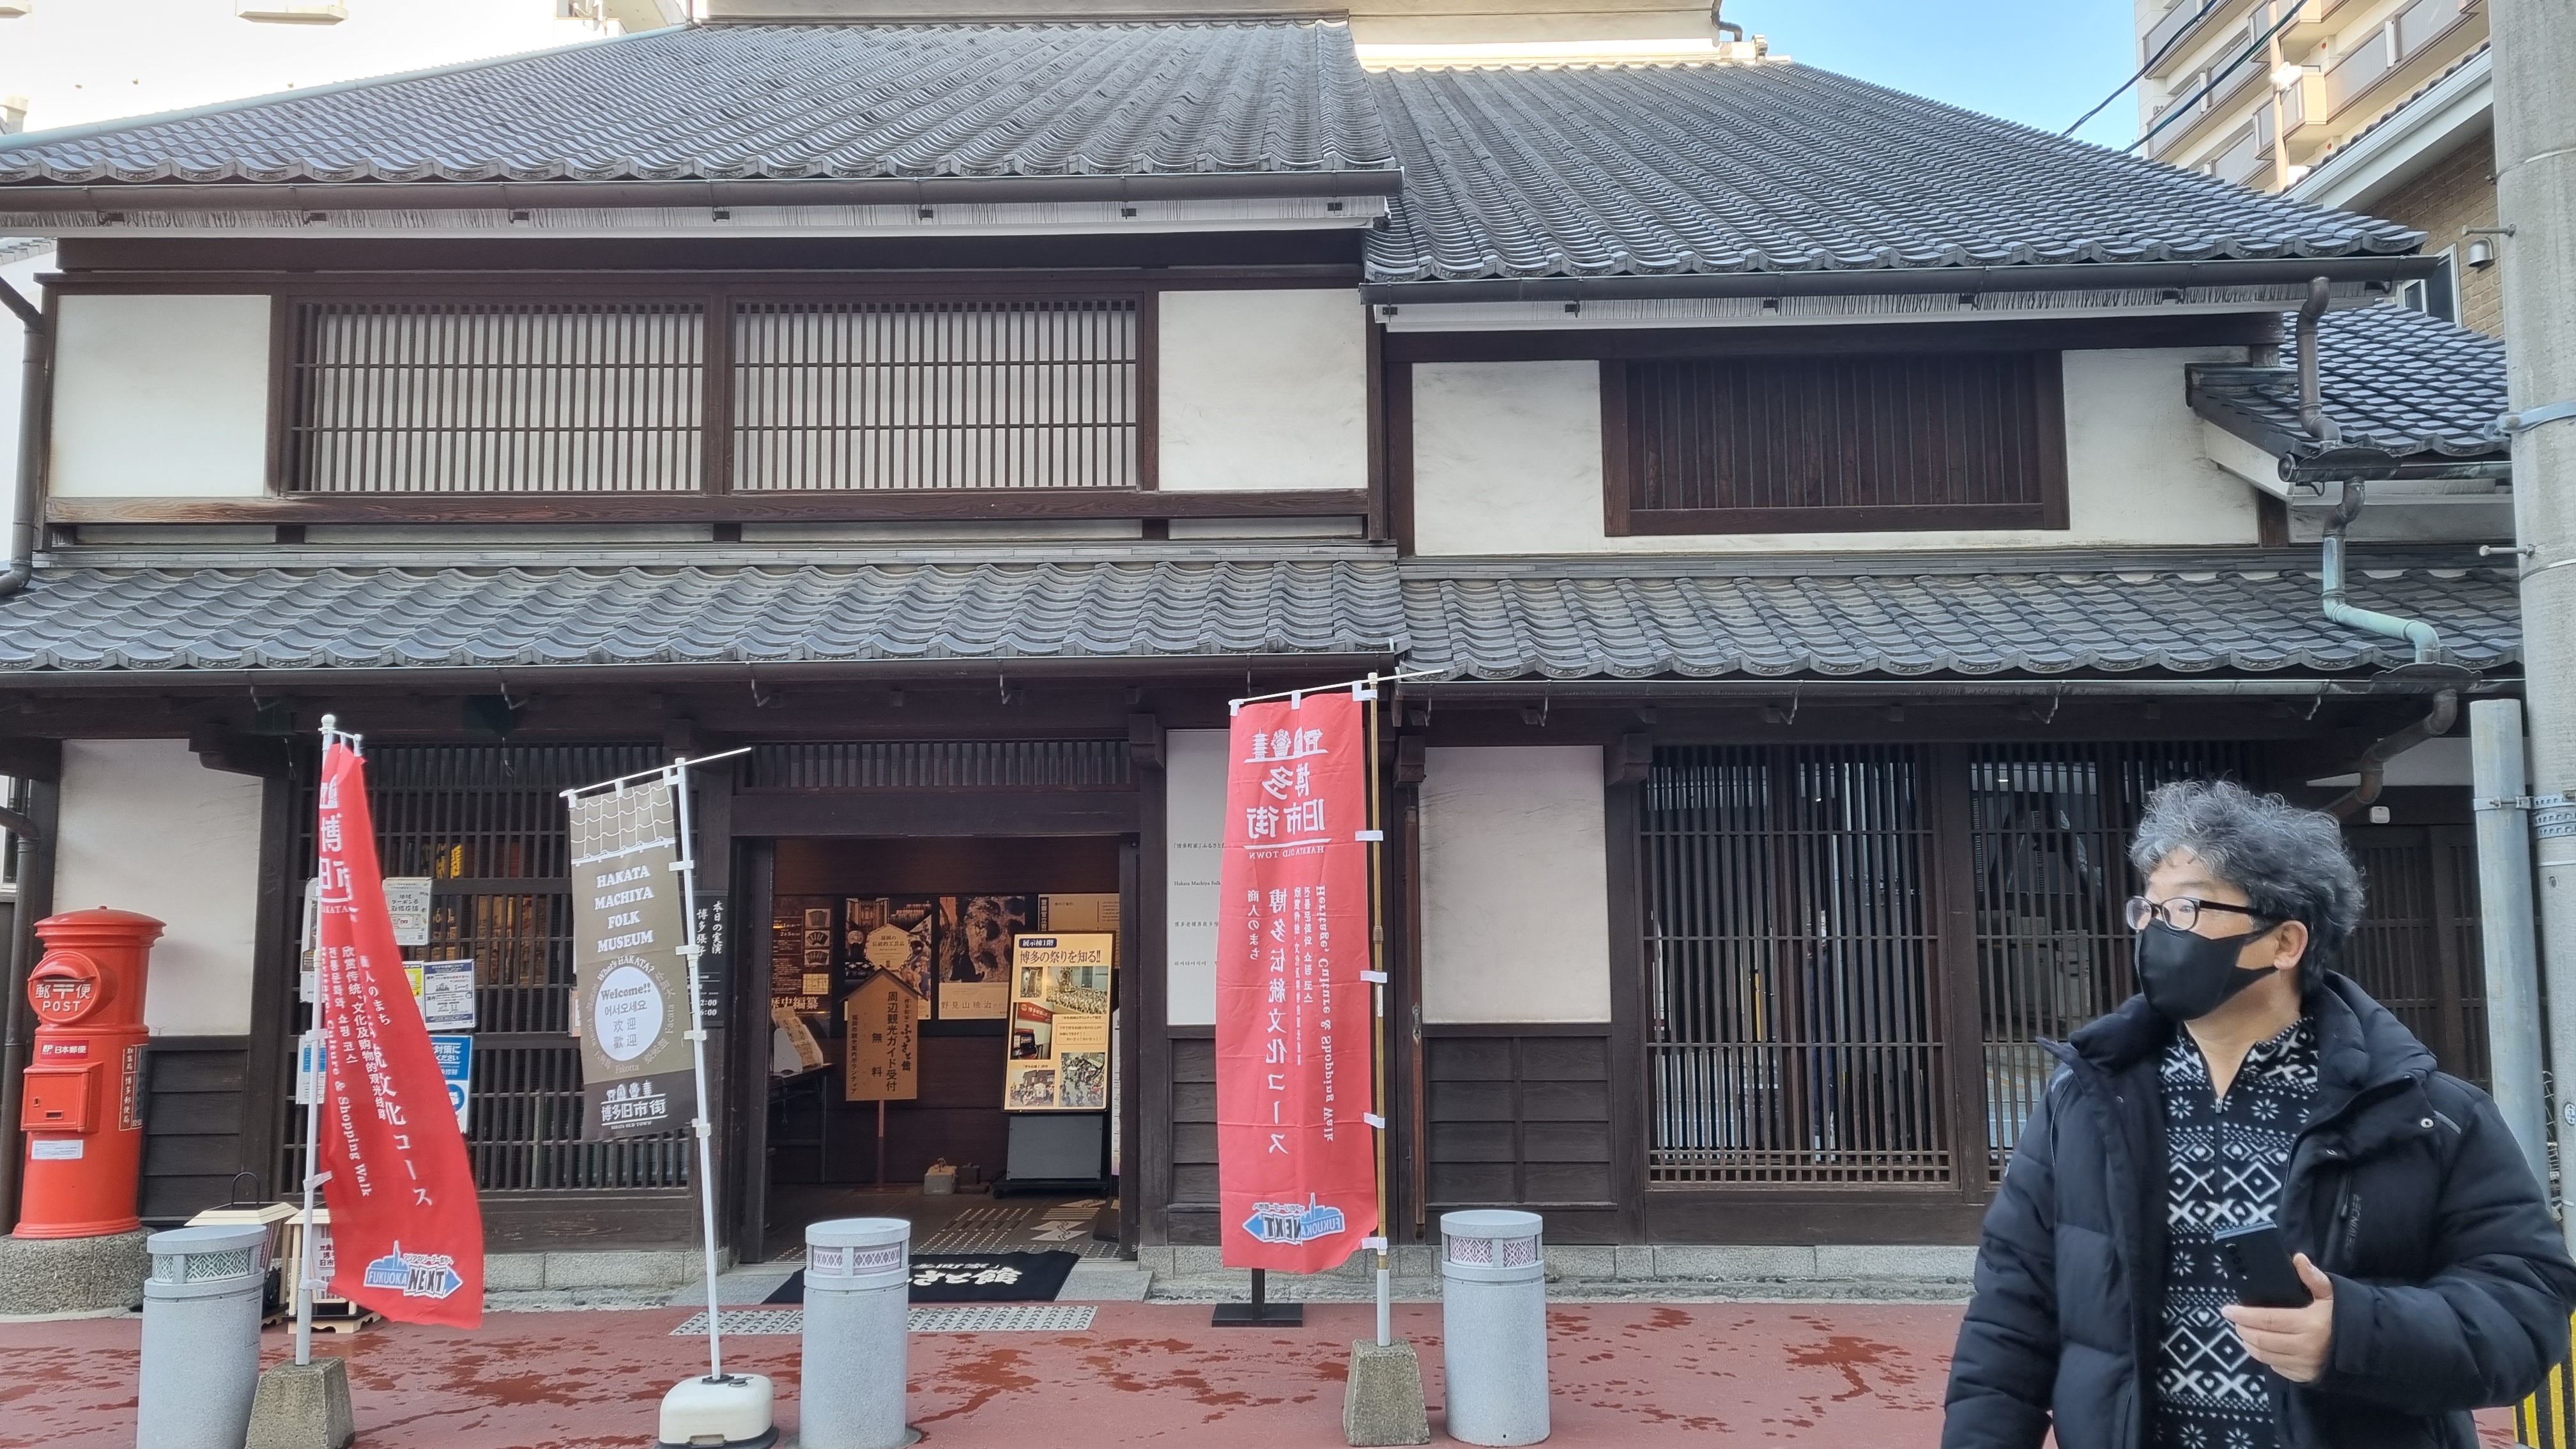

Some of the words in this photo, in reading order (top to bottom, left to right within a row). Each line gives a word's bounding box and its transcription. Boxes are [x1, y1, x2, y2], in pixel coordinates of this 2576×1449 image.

[596, 866, 651, 888] HAKATA
[594, 886, 654, 910] MACHIYA
[608, 910, 641, 930] FOLK
[712, 900, 724, 954] 本日の実演
[597, 930, 654, 953] MUSEUM
[601, 982, 651, 1001] Welcome!!
[42, 1000, 81, 1012] POST
[604, 1000, 647, 1017] 어서오세요
[54, 1045, 87, 1054] 日本郵便
[887, 992, 898, 1092] 周辺観光ガイド受付
[601, 1098, 666, 1122] 博多旧市街
[337, 1096, 361, 1160] Shopping
[355, 1163, 373, 1197] Walk
[367, 1271, 407, 1285] FUKUOKA
[408, 1269, 445, 1294] NEXT
